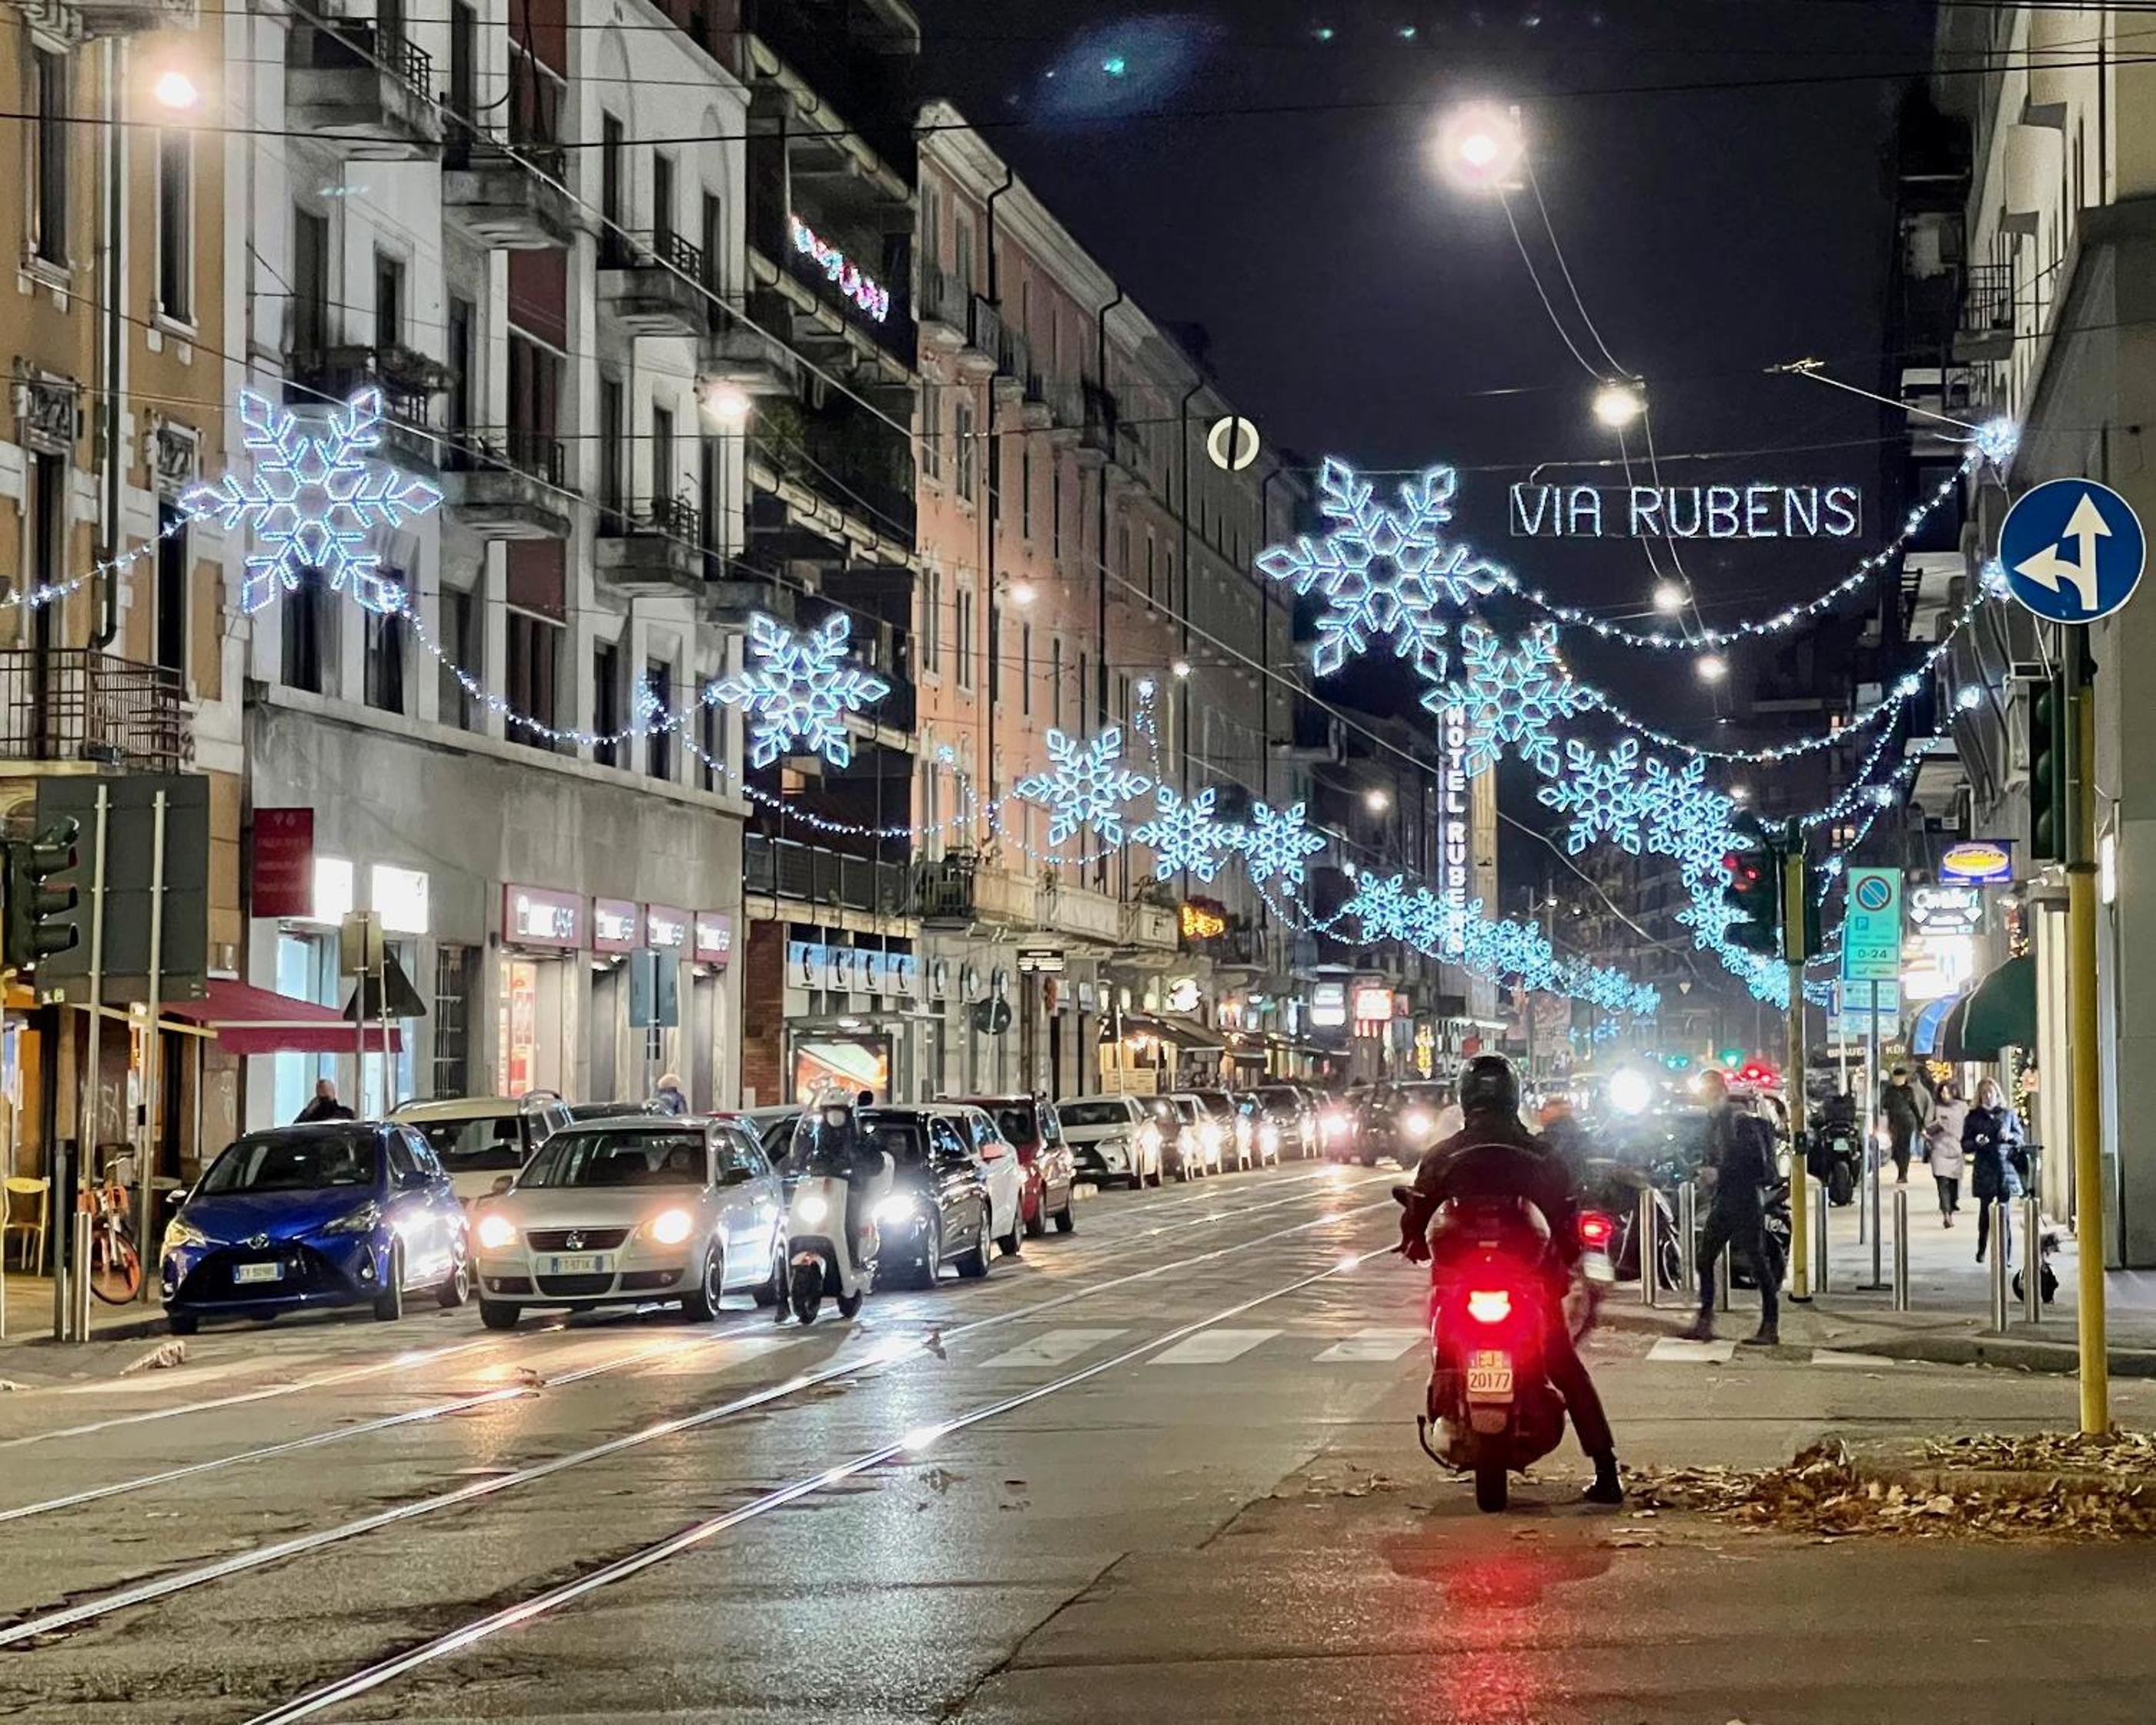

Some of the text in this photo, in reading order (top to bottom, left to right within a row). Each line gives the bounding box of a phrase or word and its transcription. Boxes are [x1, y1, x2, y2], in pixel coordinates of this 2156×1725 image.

[1513, 485, 1857, 537] VIA RUBENS
[1447, 703, 1466, 952] HOTEL RUBE
[1469, 1372, 1510, 1389] 20177
